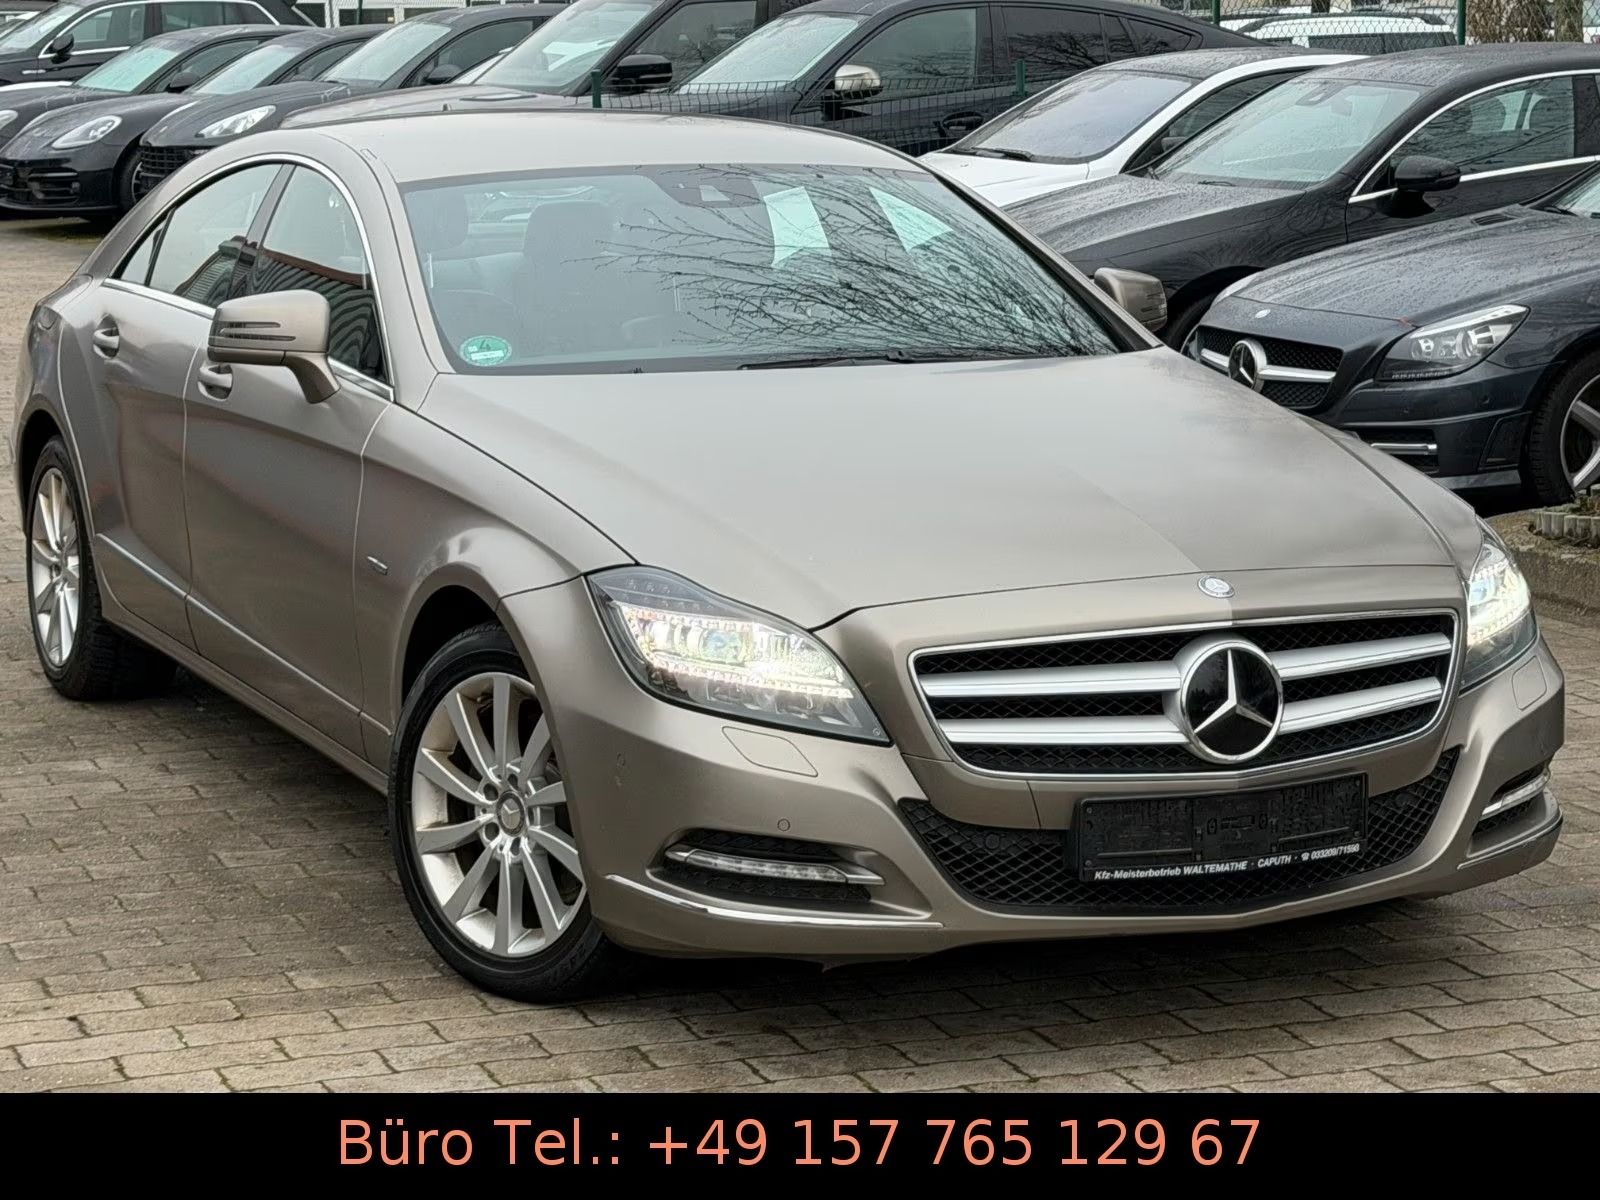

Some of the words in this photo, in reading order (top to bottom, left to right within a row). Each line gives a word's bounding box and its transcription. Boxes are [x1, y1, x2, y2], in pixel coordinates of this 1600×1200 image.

[1094, 866, 1181, 880] Kfz-Meisterbetrieb
[1183, 861, 1248, 875] WALTEMATHE
[1257, 855, 1292, 868] CAPUTH
